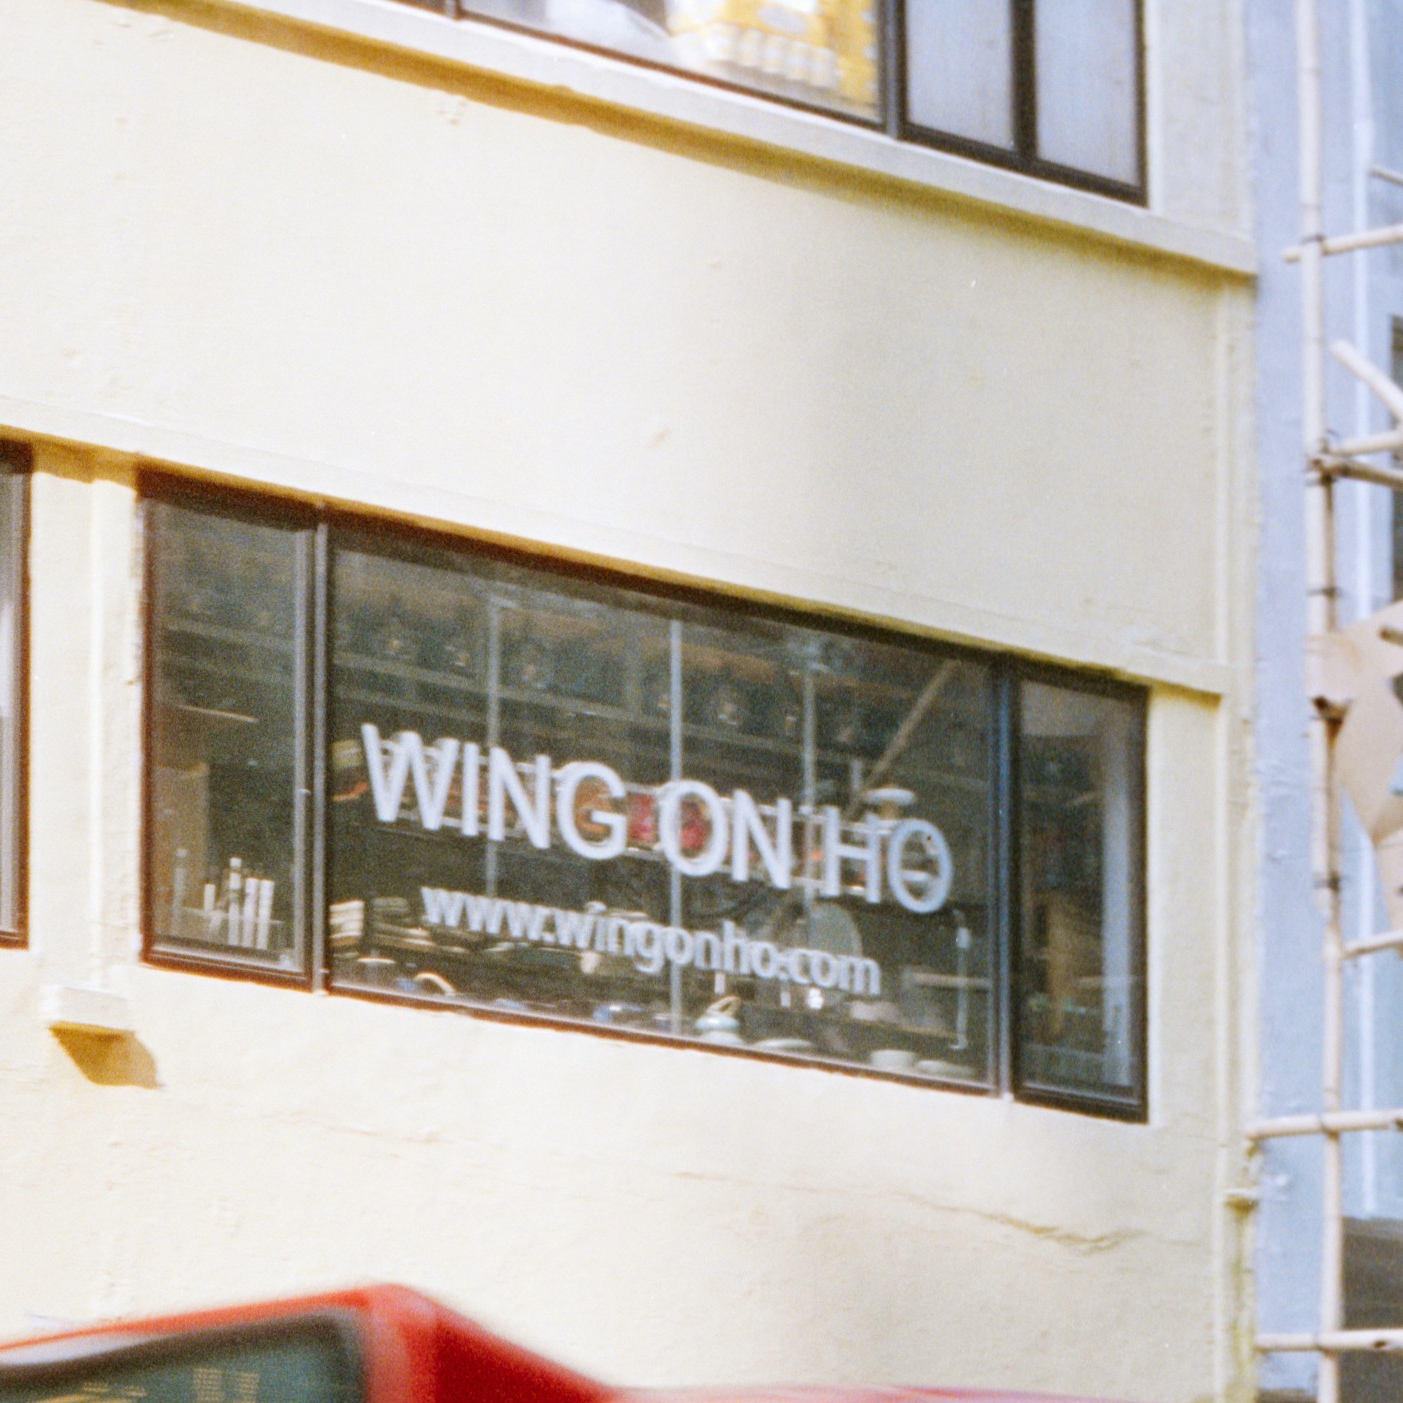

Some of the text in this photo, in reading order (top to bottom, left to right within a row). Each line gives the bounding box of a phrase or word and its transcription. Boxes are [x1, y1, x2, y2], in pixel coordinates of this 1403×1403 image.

[360, 722, 953, 914] WING ON HO
[420, 886, 881, 996] www.wingonho.com
